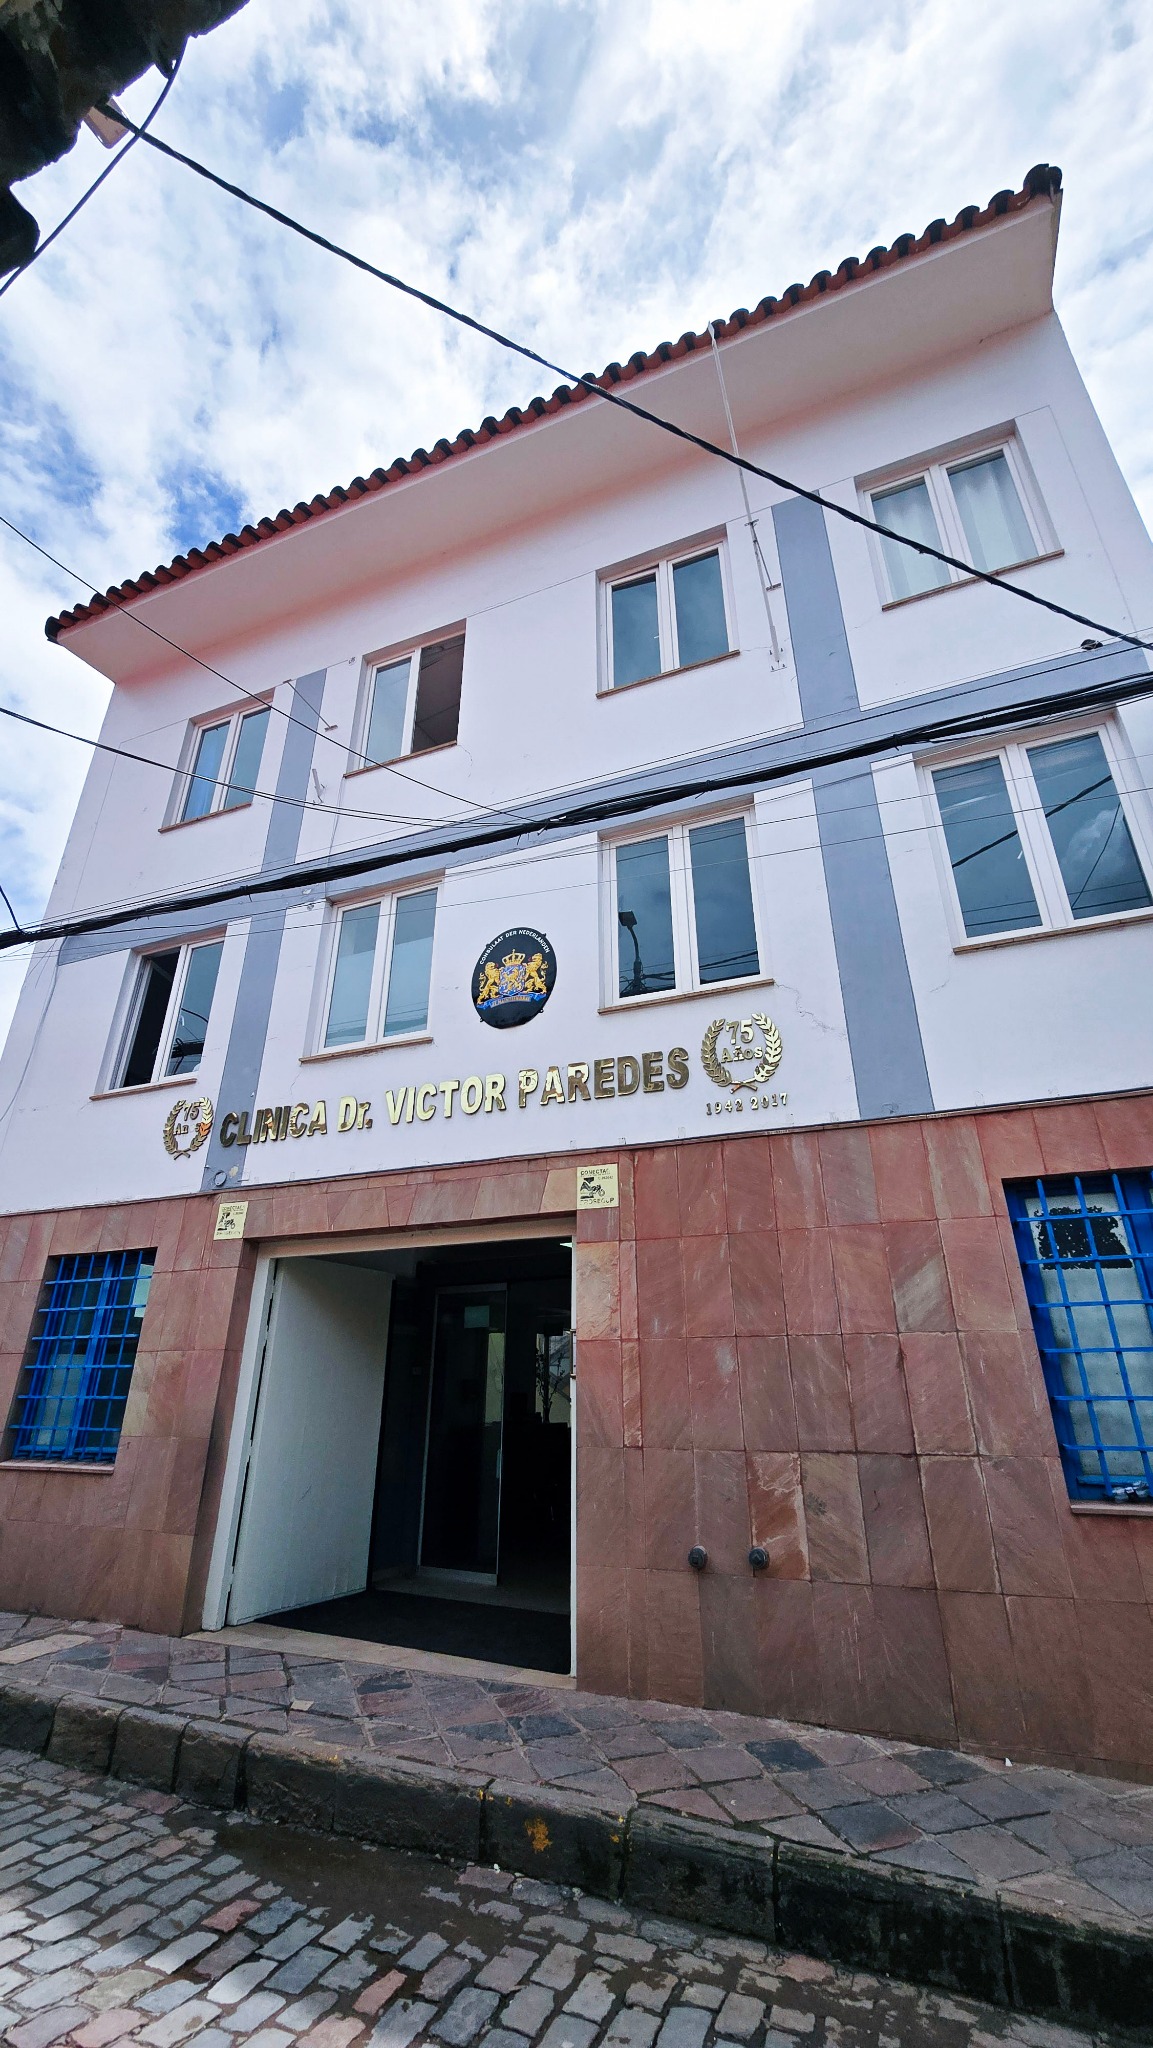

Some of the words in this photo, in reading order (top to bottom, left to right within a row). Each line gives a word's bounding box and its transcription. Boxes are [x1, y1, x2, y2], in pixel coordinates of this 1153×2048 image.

[479, 935, 504, 965] CONSULAAT
[505, 930, 517, 938] DER
[518, 929, 551, 954] NEDERLANDEN
[725, 1018, 755, 1045] 75
[720, 1045, 763, 1063] Años
[219, 1100, 328, 1148] CLINICA
[337, 1095, 373, 1133] Dr.
[385, 1072, 506, 1126] VICTOR
[518, 1047, 690, 1108] PAREDES
[705, 1098, 744, 1116] 1942
[749, 1092, 788, 1111] 2017
[183, 1101, 202, 1122] 75
